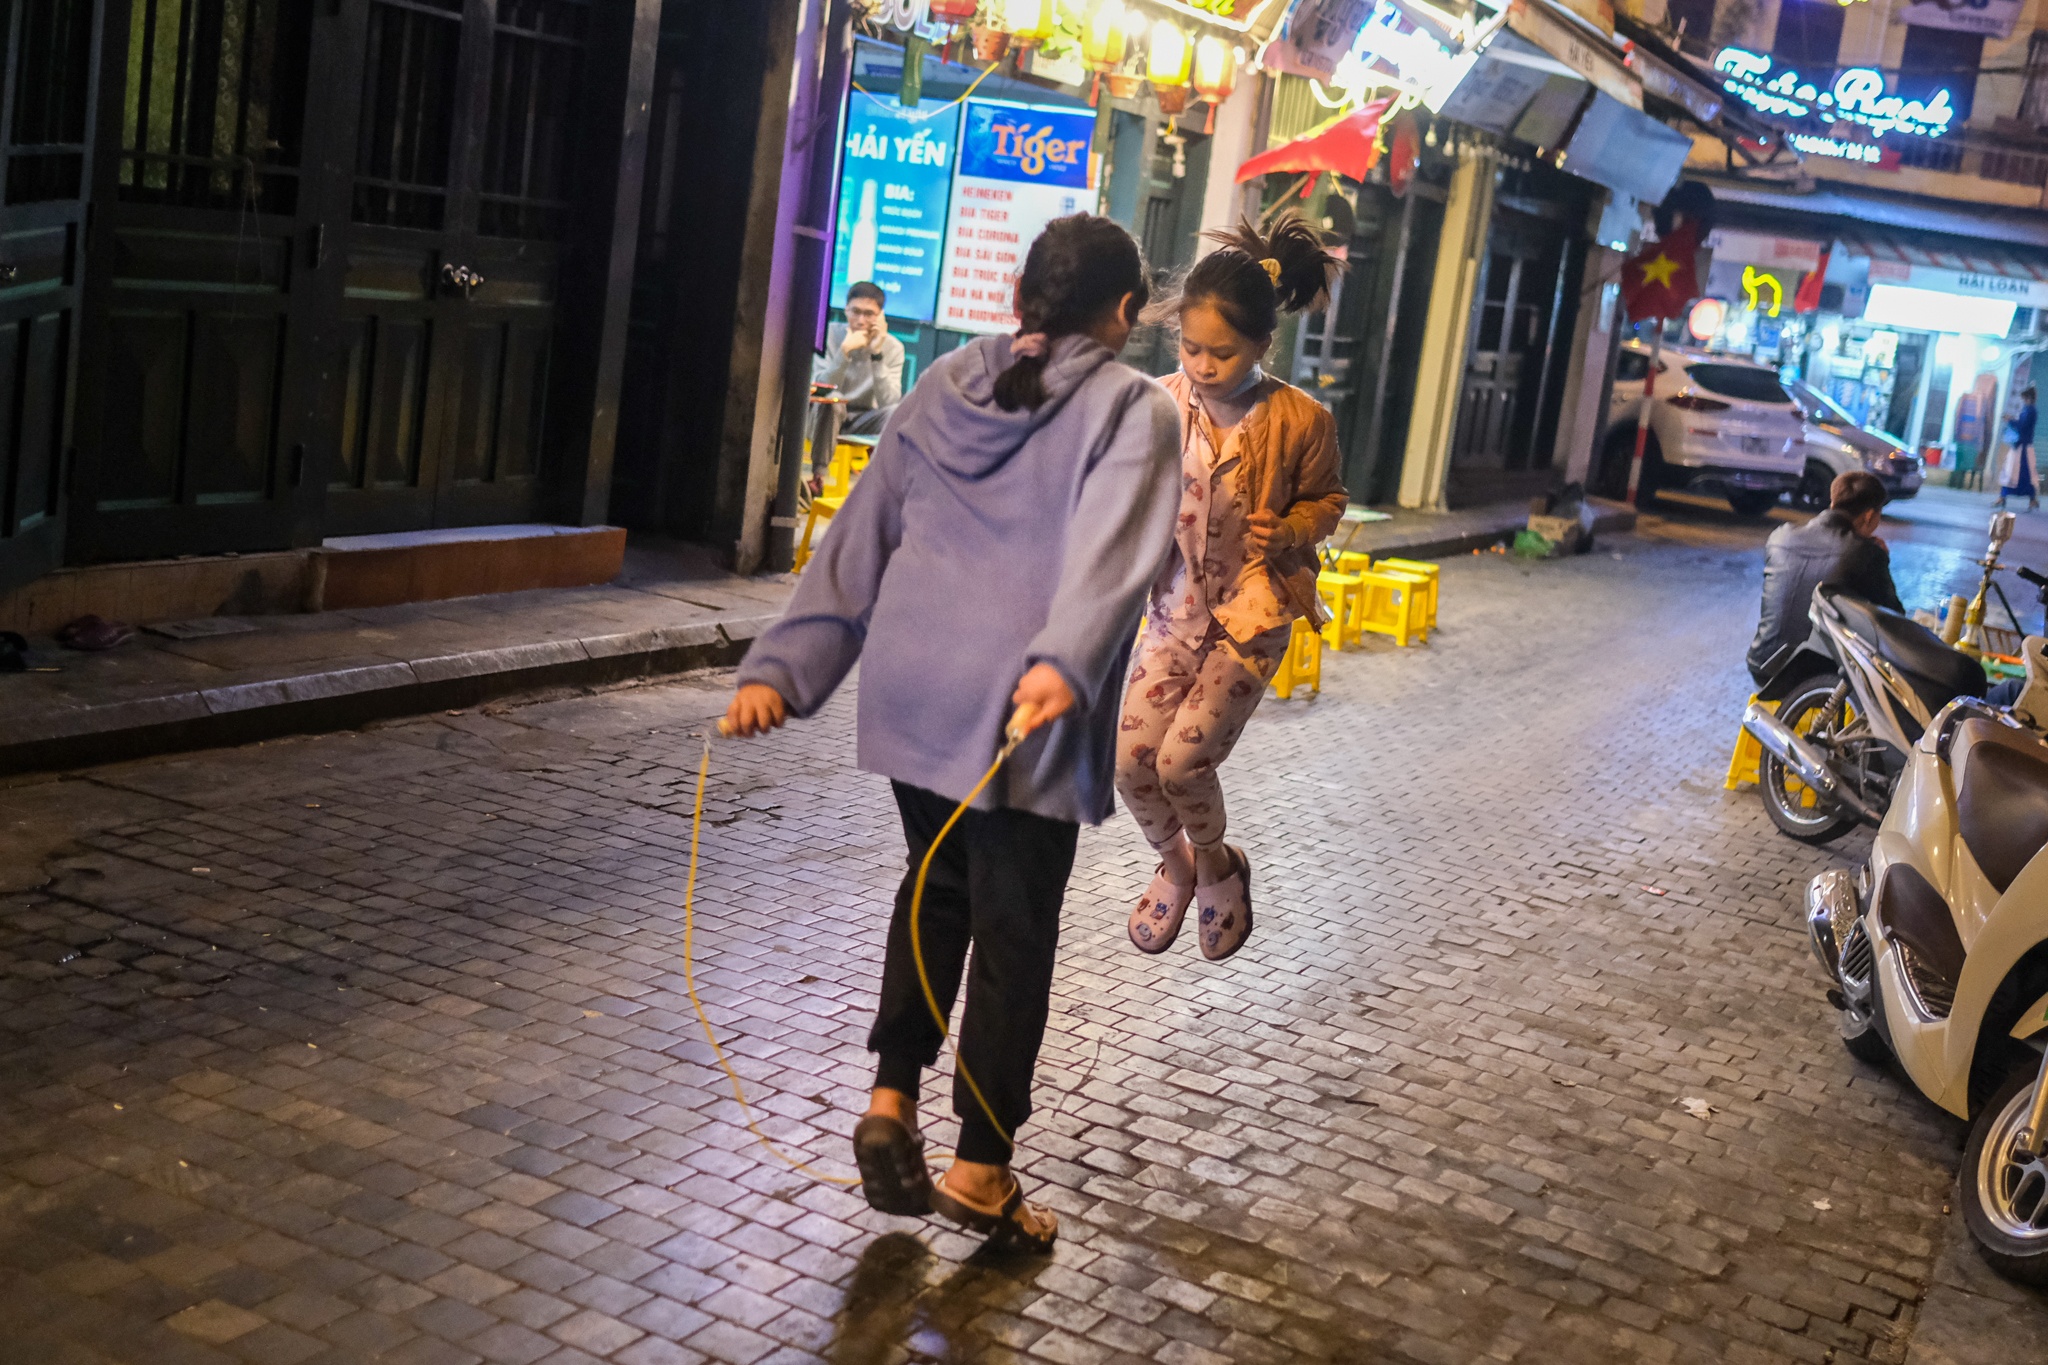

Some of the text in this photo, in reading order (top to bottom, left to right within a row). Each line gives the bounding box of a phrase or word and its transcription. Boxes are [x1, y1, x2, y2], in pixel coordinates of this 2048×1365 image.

[894, 128, 946, 167] YẾN
[991, 123, 1085, 175] Tiger
[962, 186, 1013, 201] HEINEKEN
[960, 206, 1008, 222] BIA TIGER
[958, 226, 1019, 244] BIA CORONA
[955, 246, 970, 259] BIA
[953, 266, 968, 279] BIA
[951, 286, 966, 299] BIA
[948, 306, 964, 318] BIA
